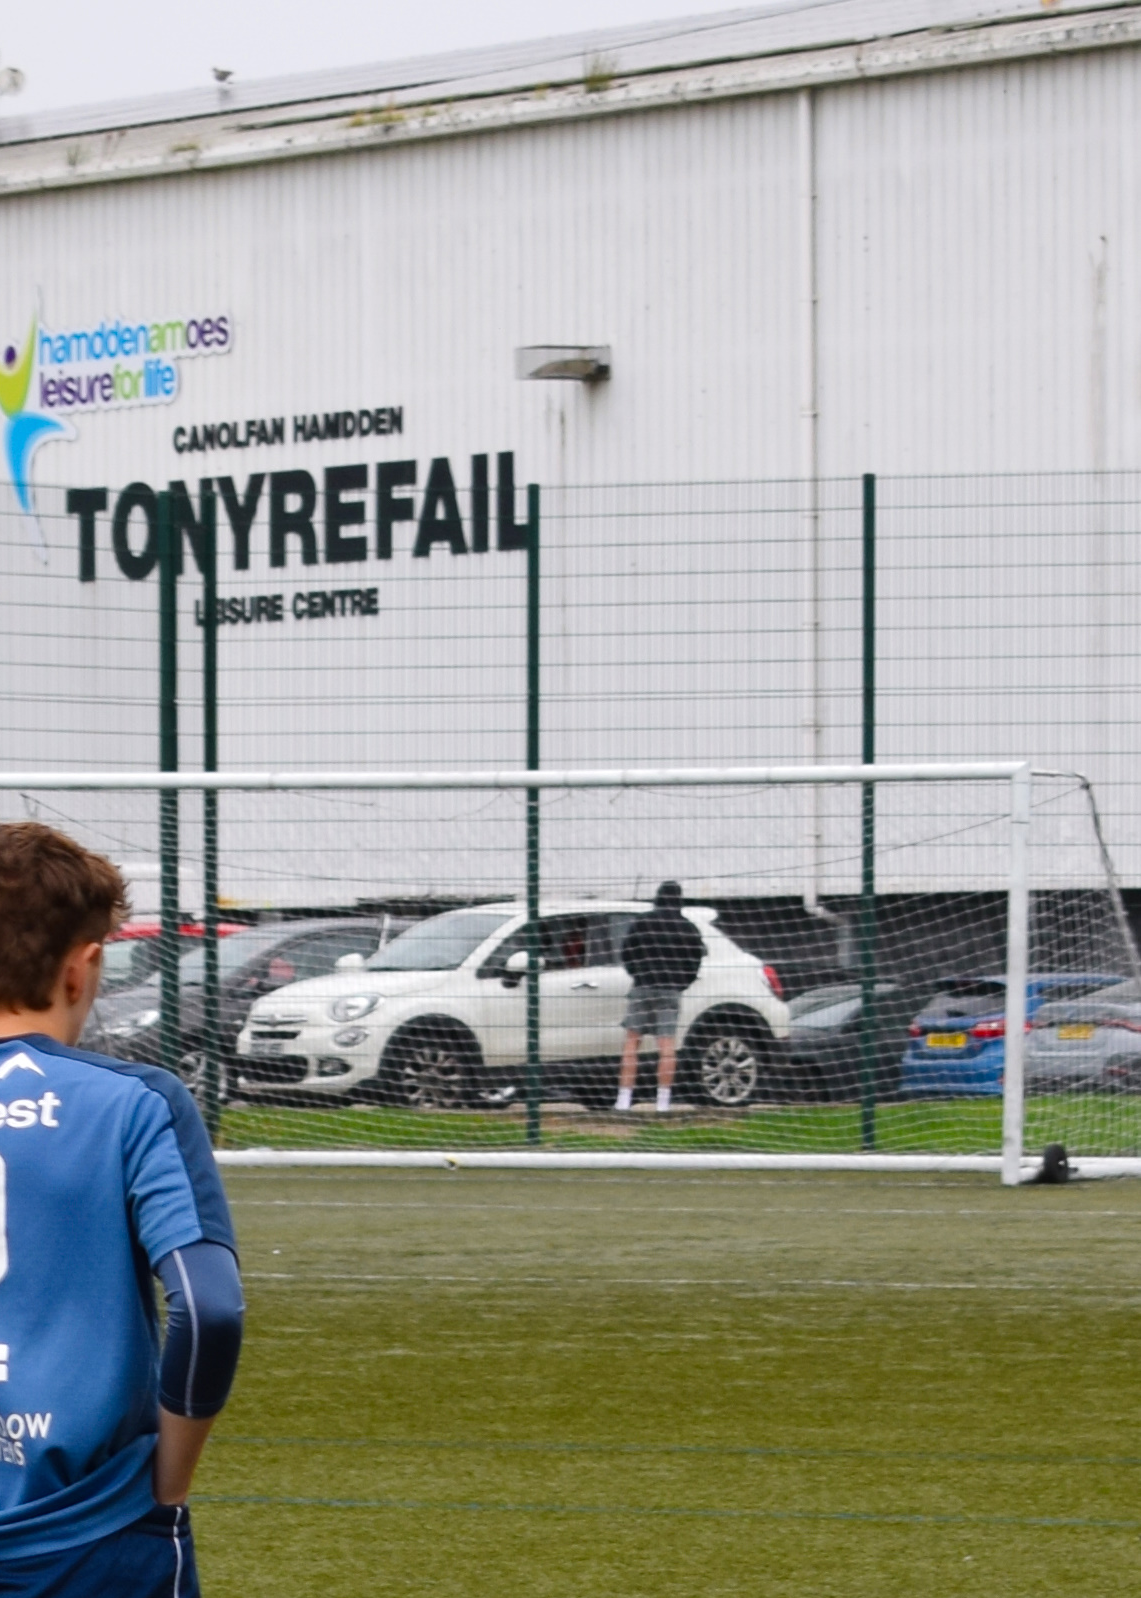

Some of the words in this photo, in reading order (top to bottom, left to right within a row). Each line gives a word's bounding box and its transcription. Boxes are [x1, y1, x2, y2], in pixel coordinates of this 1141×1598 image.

[173, 416, 285, 454] CANOLFAN
[293, 405, 403, 443] HAMDDEN
[66, 451, 531, 582] TONYREFAIL
[292, 587, 379, 620] CENTRE
